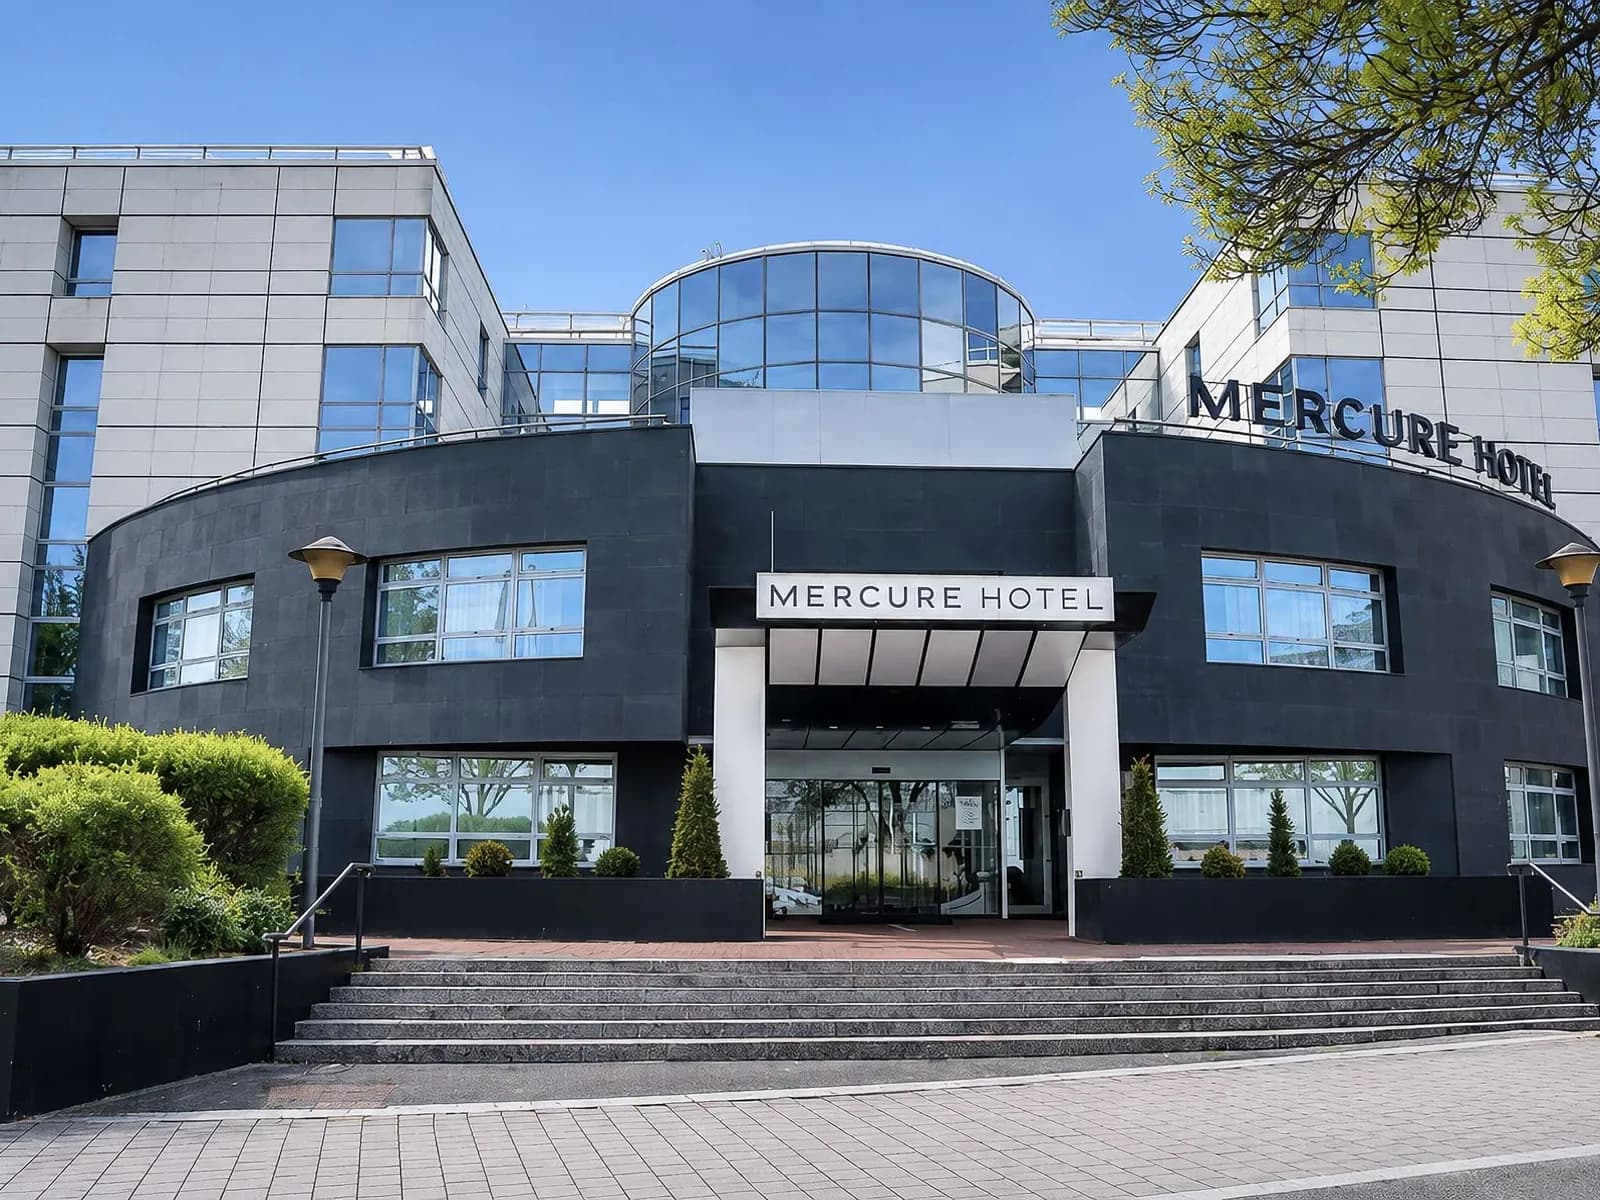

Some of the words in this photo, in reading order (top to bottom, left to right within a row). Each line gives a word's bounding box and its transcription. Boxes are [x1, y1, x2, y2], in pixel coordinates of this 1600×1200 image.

[1188, 376, 1463, 466] MERCURE
[1473, 436, 1555, 510] HOTEL
[770, 584, 961, 609] MERCURE
[981, 587, 1103, 610] HOTEL
